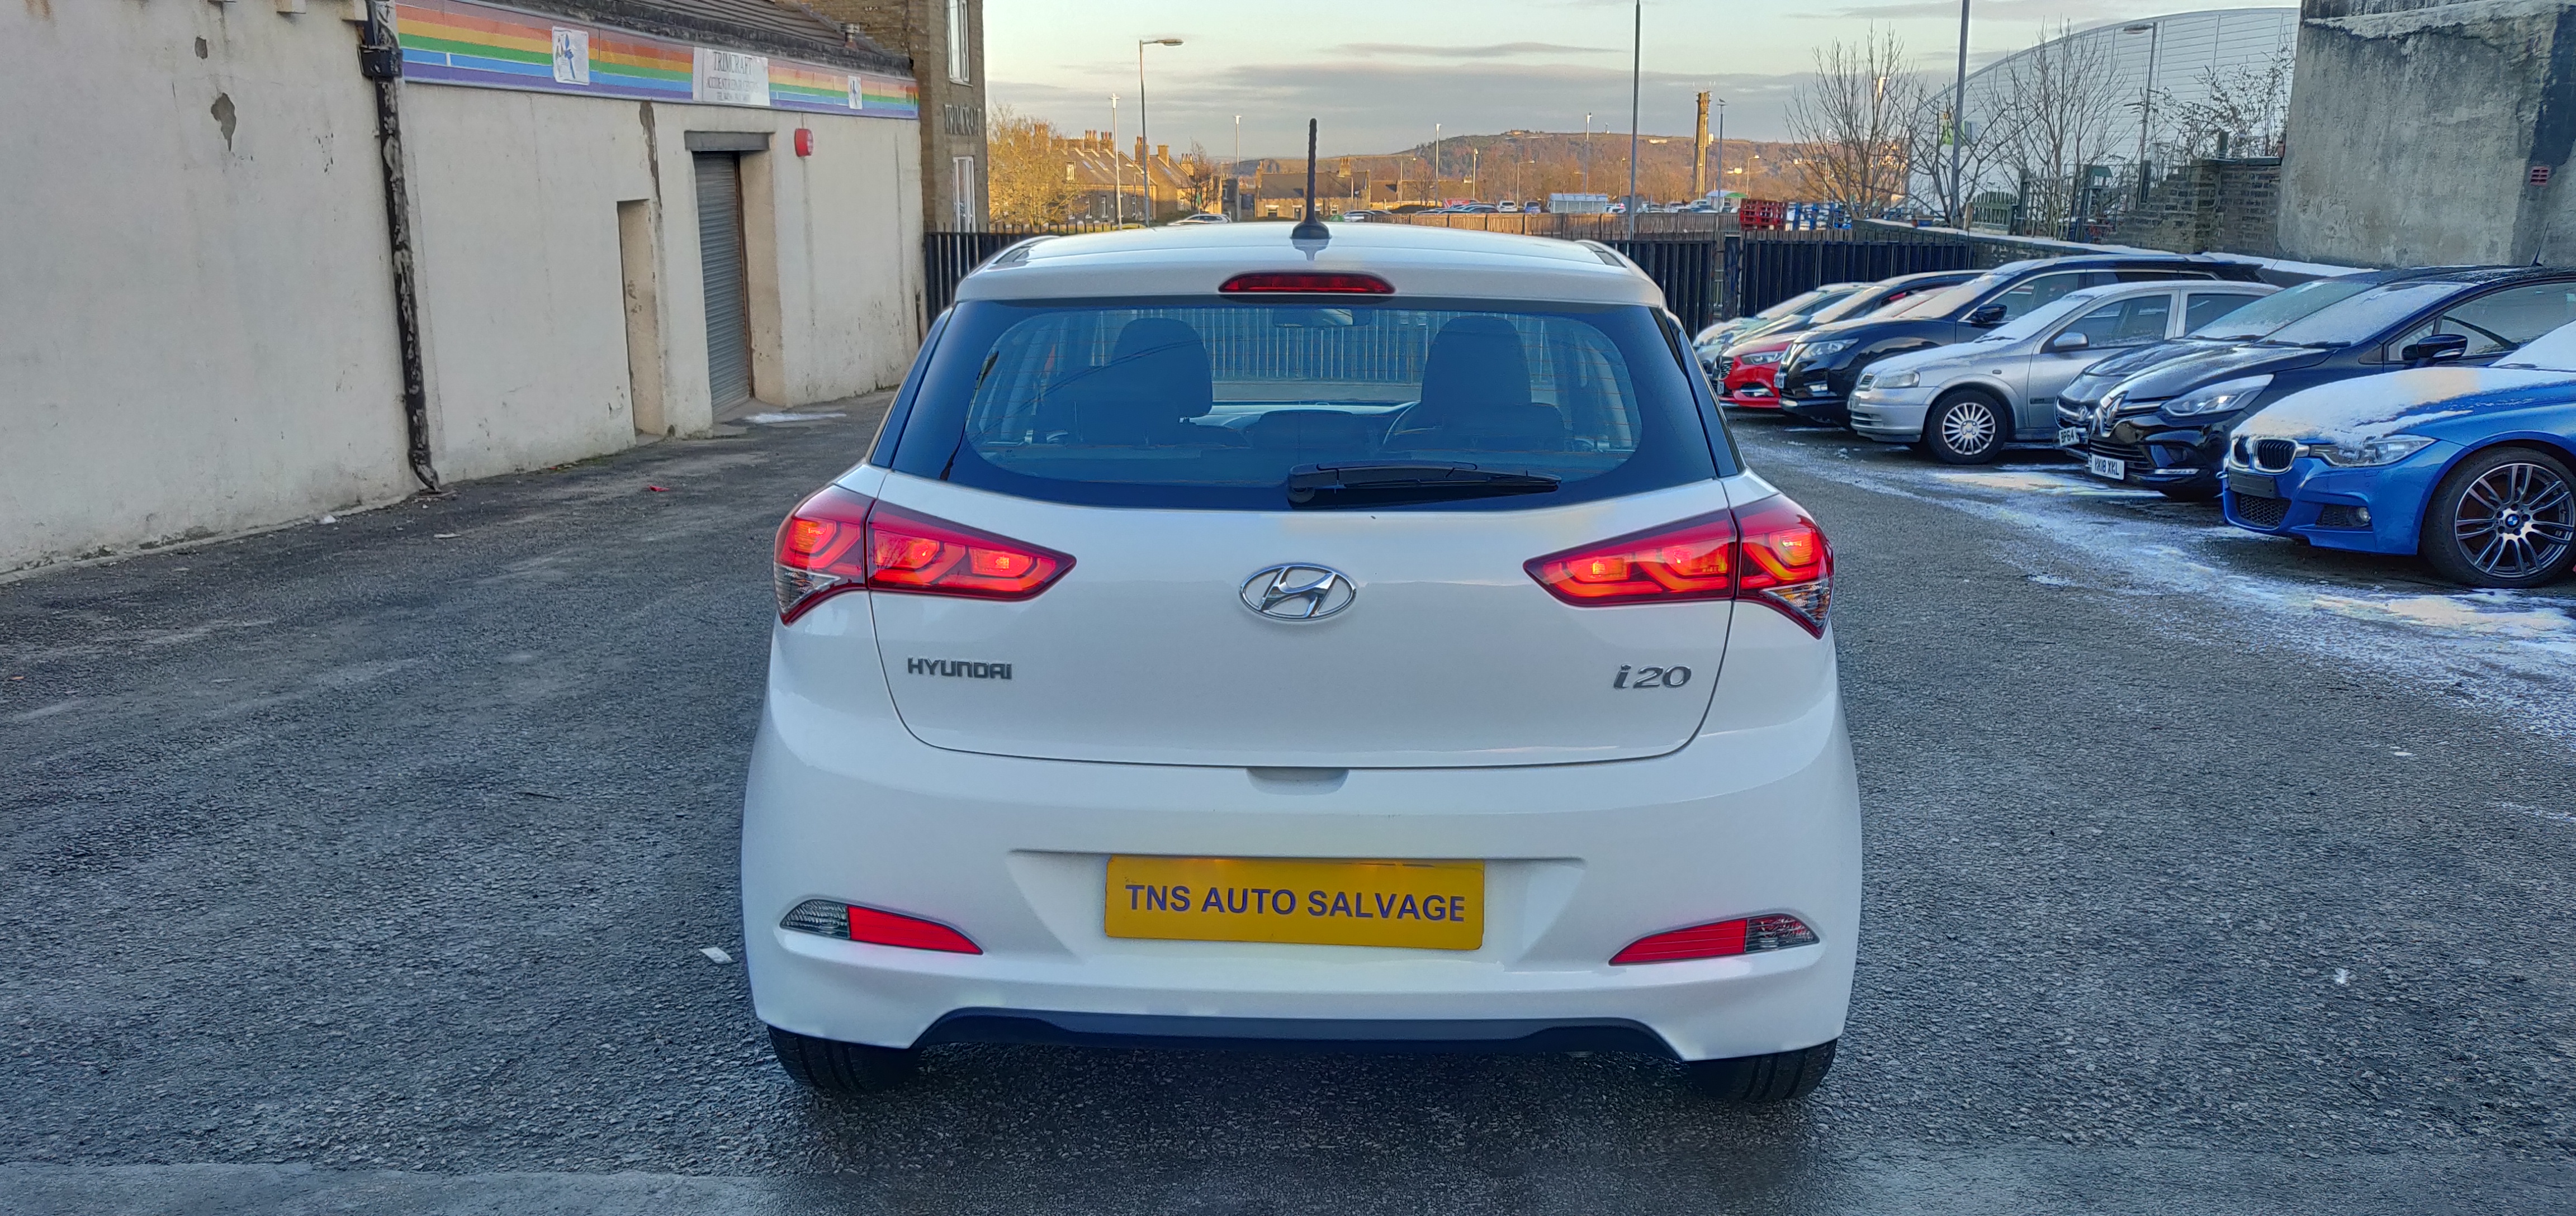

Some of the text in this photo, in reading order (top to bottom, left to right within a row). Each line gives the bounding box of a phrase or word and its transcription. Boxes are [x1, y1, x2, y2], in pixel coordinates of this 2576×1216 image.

[907, 656, 1012, 680] HYUNDAI
[1613, 663, 1692, 689] i20
[1125, 885, 1466, 923] TNS AUTO SALVAGE
